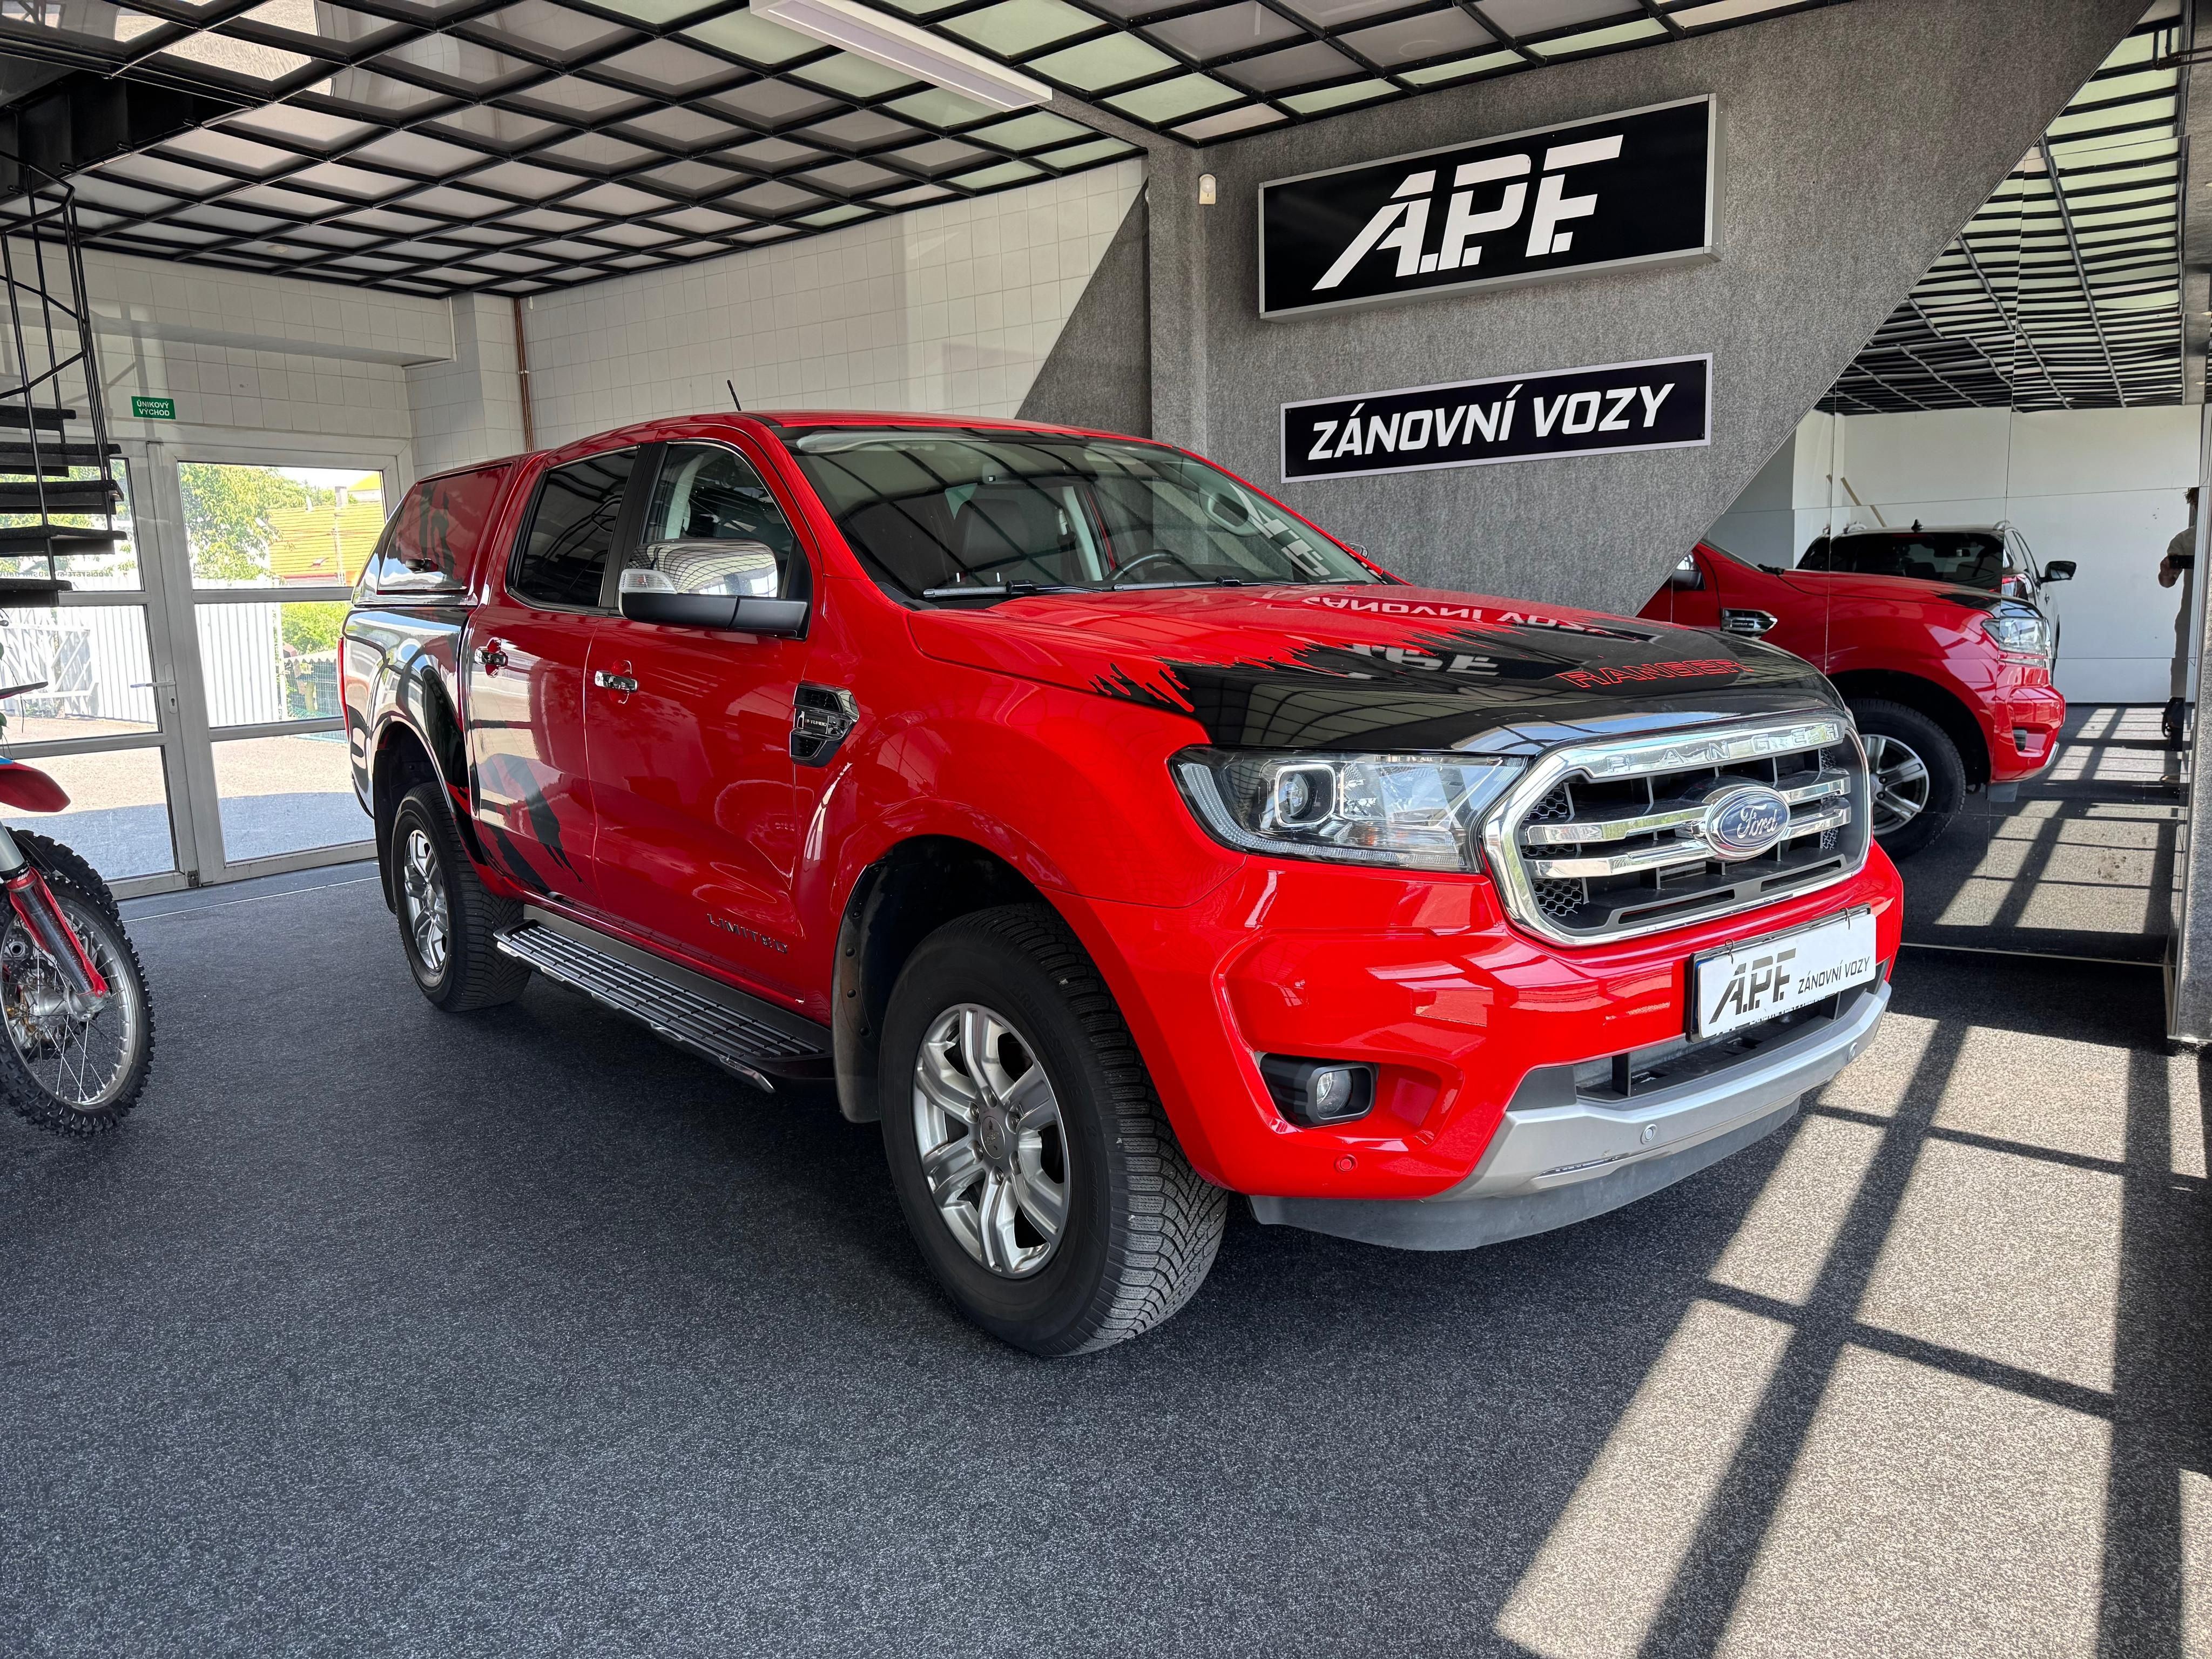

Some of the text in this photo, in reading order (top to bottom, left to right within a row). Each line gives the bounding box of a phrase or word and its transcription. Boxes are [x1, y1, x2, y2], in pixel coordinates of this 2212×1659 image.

[136, 399, 169, 409] ÚNIKOVÝ
[138, 407, 170, 416] VÝCHOD
[1307, 383, 1676, 461] ZÁNOVNÍ VOZY
[1555, 659, 1755, 688] RANGER
[1606, 723, 1839, 773] RANGER
[1737, 804, 1778, 839] Ford
[706, 913, 788, 954] LIMITED
[1798, 956, 1870, 994] ZÁNOVNÍ VOZY
